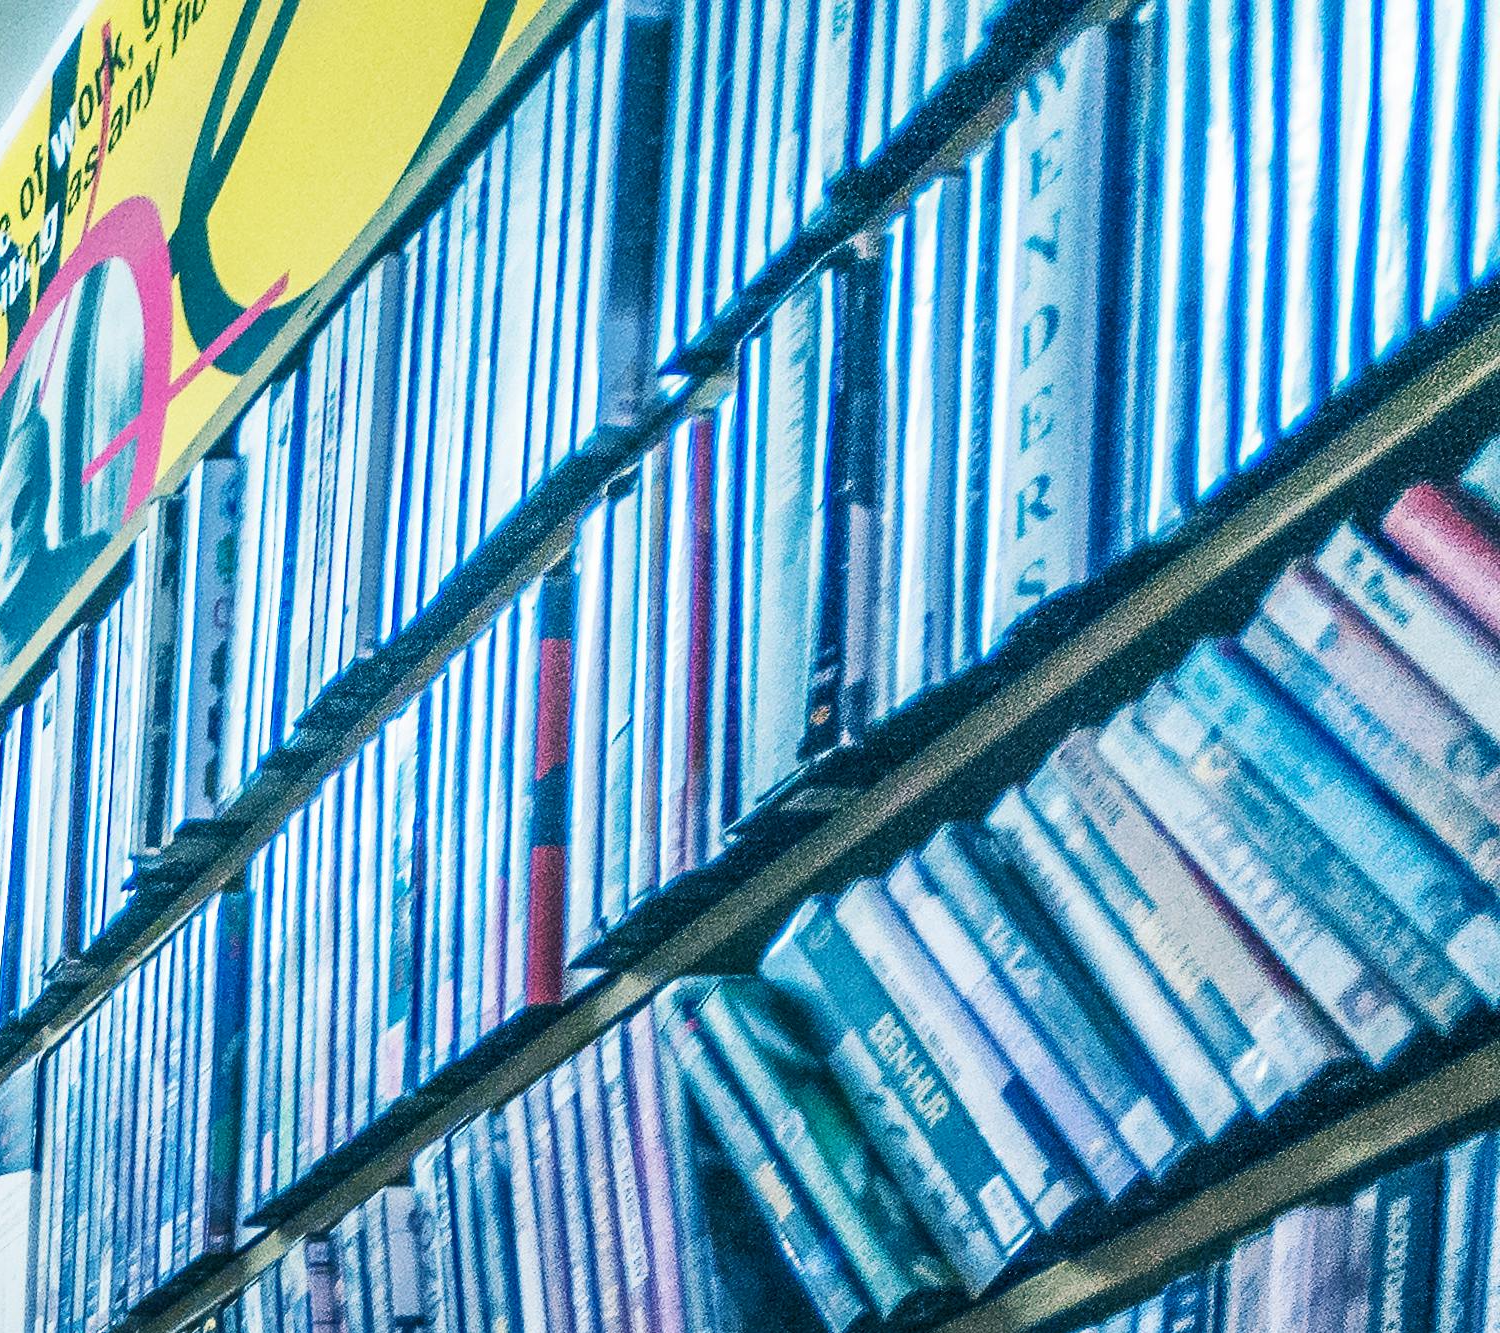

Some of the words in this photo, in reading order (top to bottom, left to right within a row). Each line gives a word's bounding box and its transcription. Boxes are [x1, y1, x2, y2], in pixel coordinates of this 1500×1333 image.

[18, 148, 49, 222] of
[51, 45, 134, 170] work,
[67, 148, 100, 217] as
[108, 64, 160, 153] any
[867, 1013, 950, 1132] BEN-HUR
